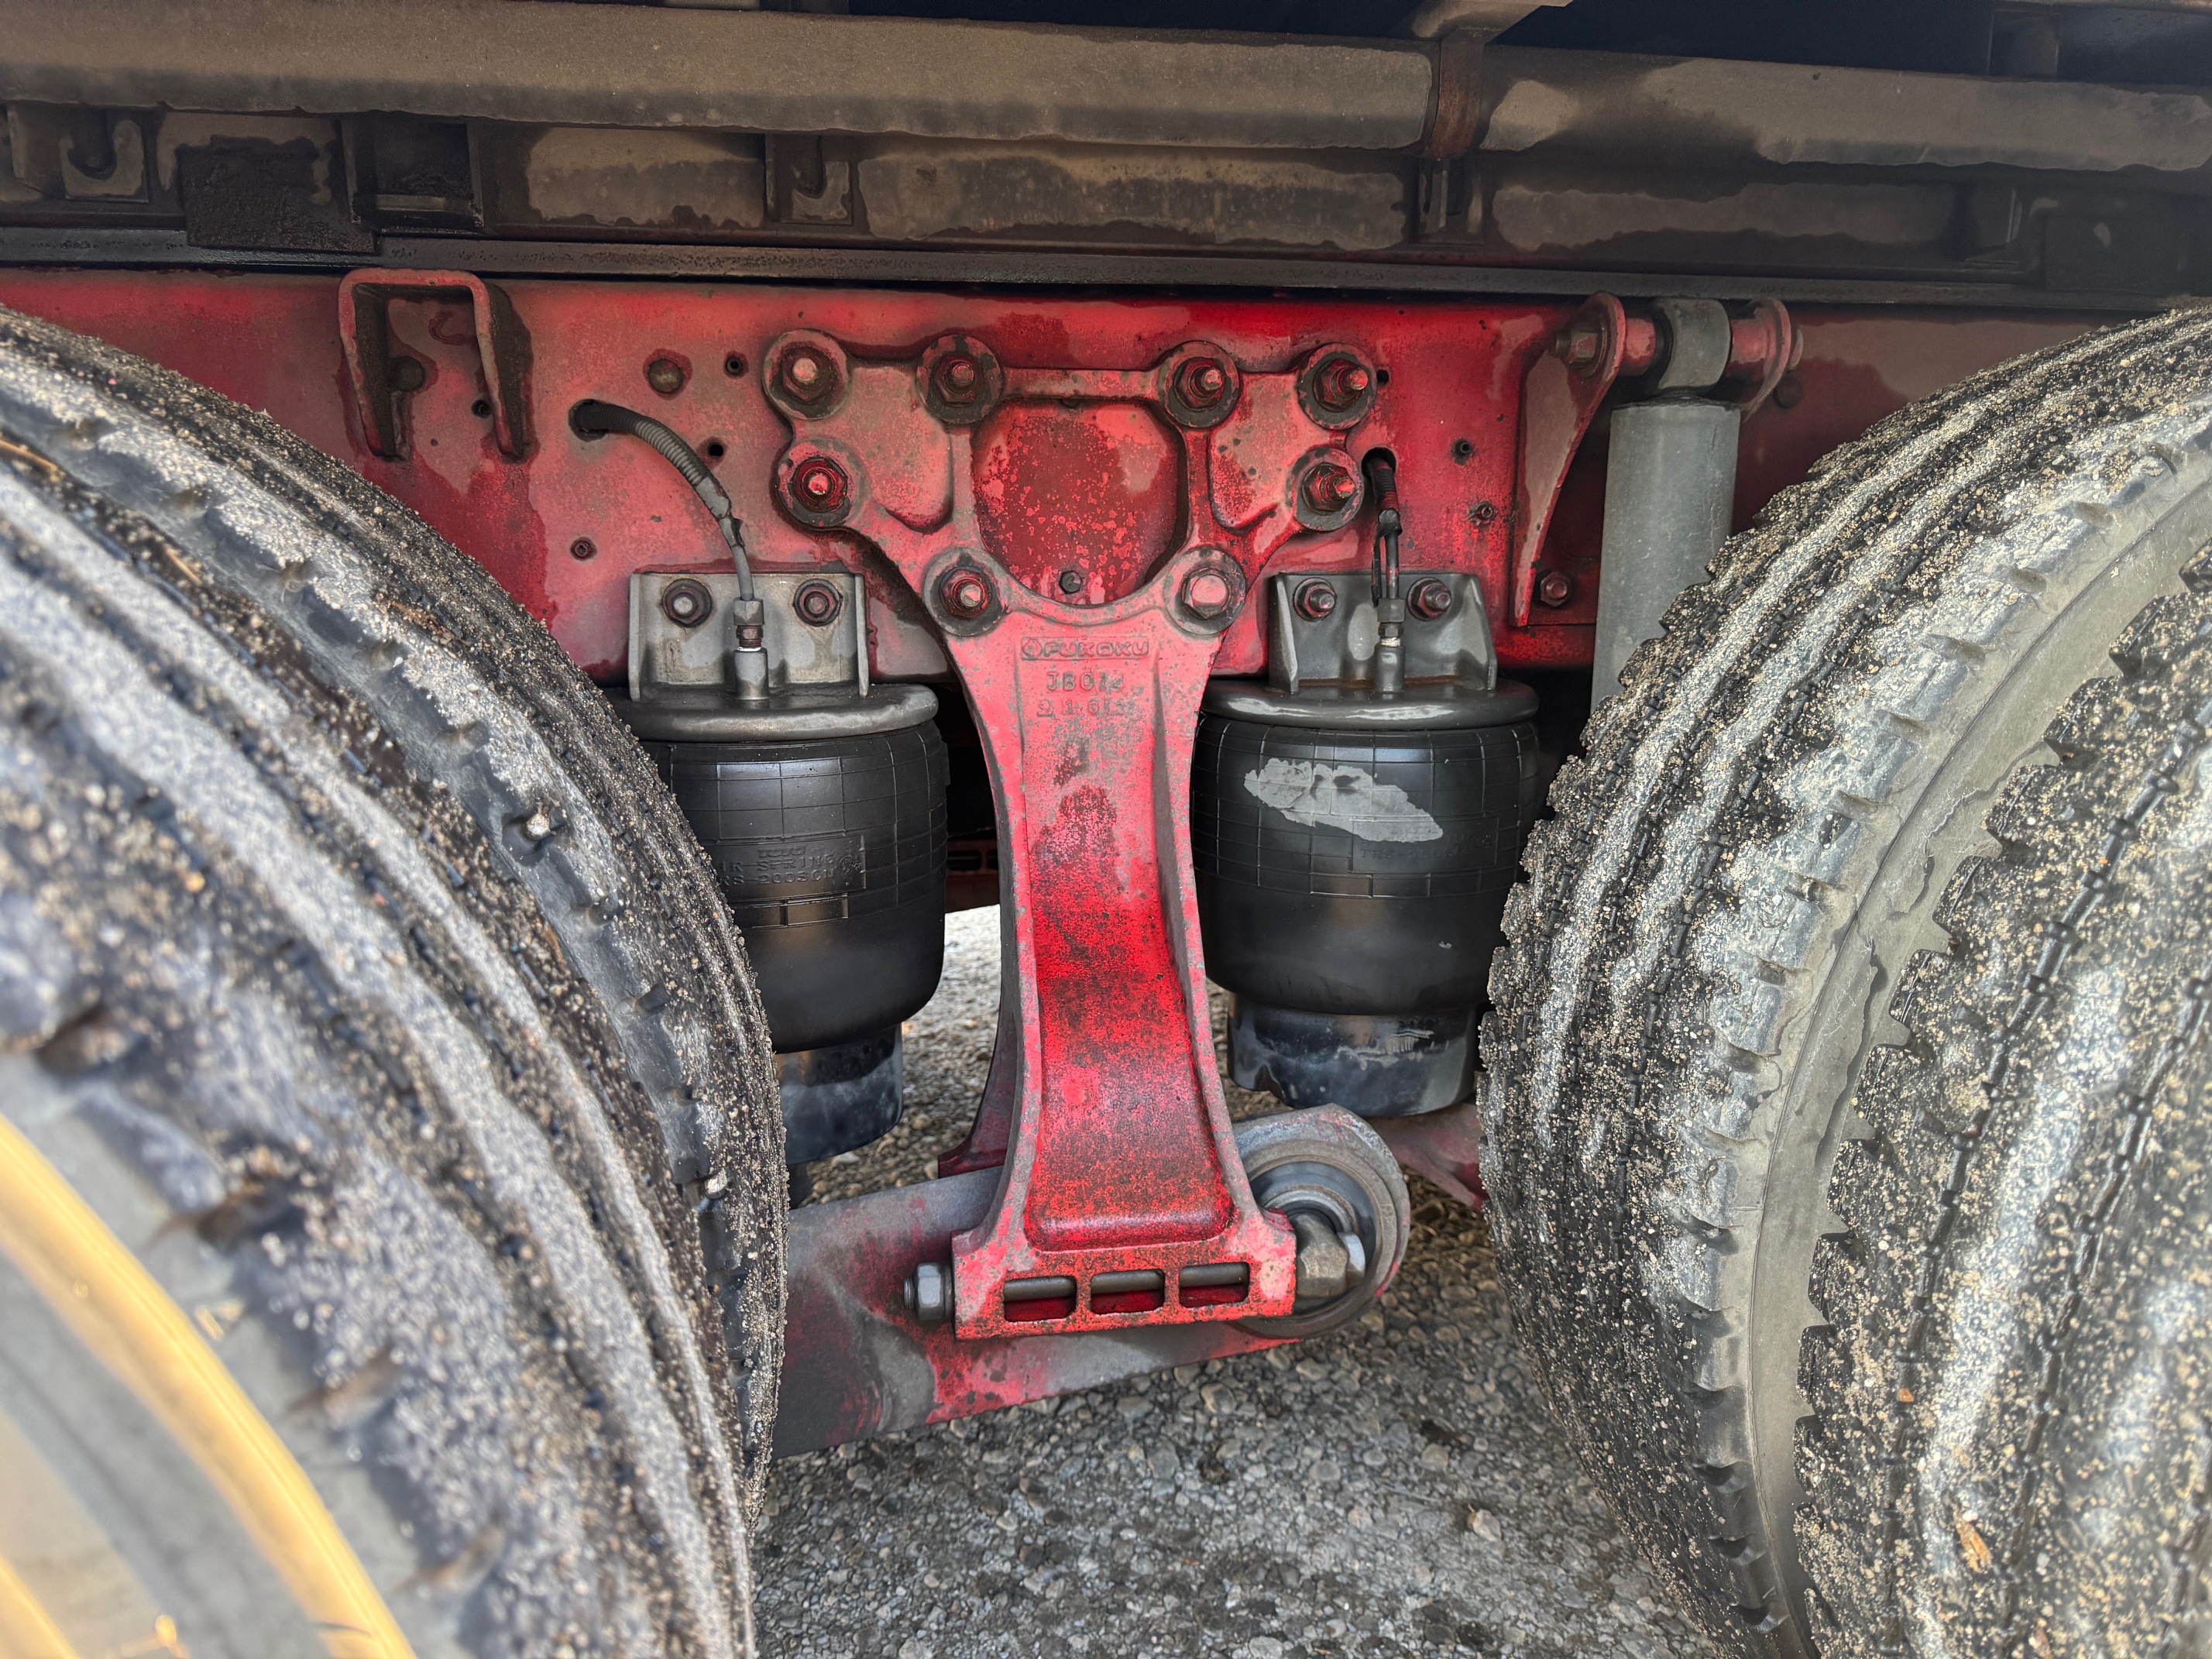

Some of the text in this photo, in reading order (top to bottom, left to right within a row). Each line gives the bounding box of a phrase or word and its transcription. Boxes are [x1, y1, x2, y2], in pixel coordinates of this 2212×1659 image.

[1043, 641, 1149, 658] FUKOKU
[721, 854, 834, 871] IR-SPRING
[719, 867, 835, 886] RS-200SCN
